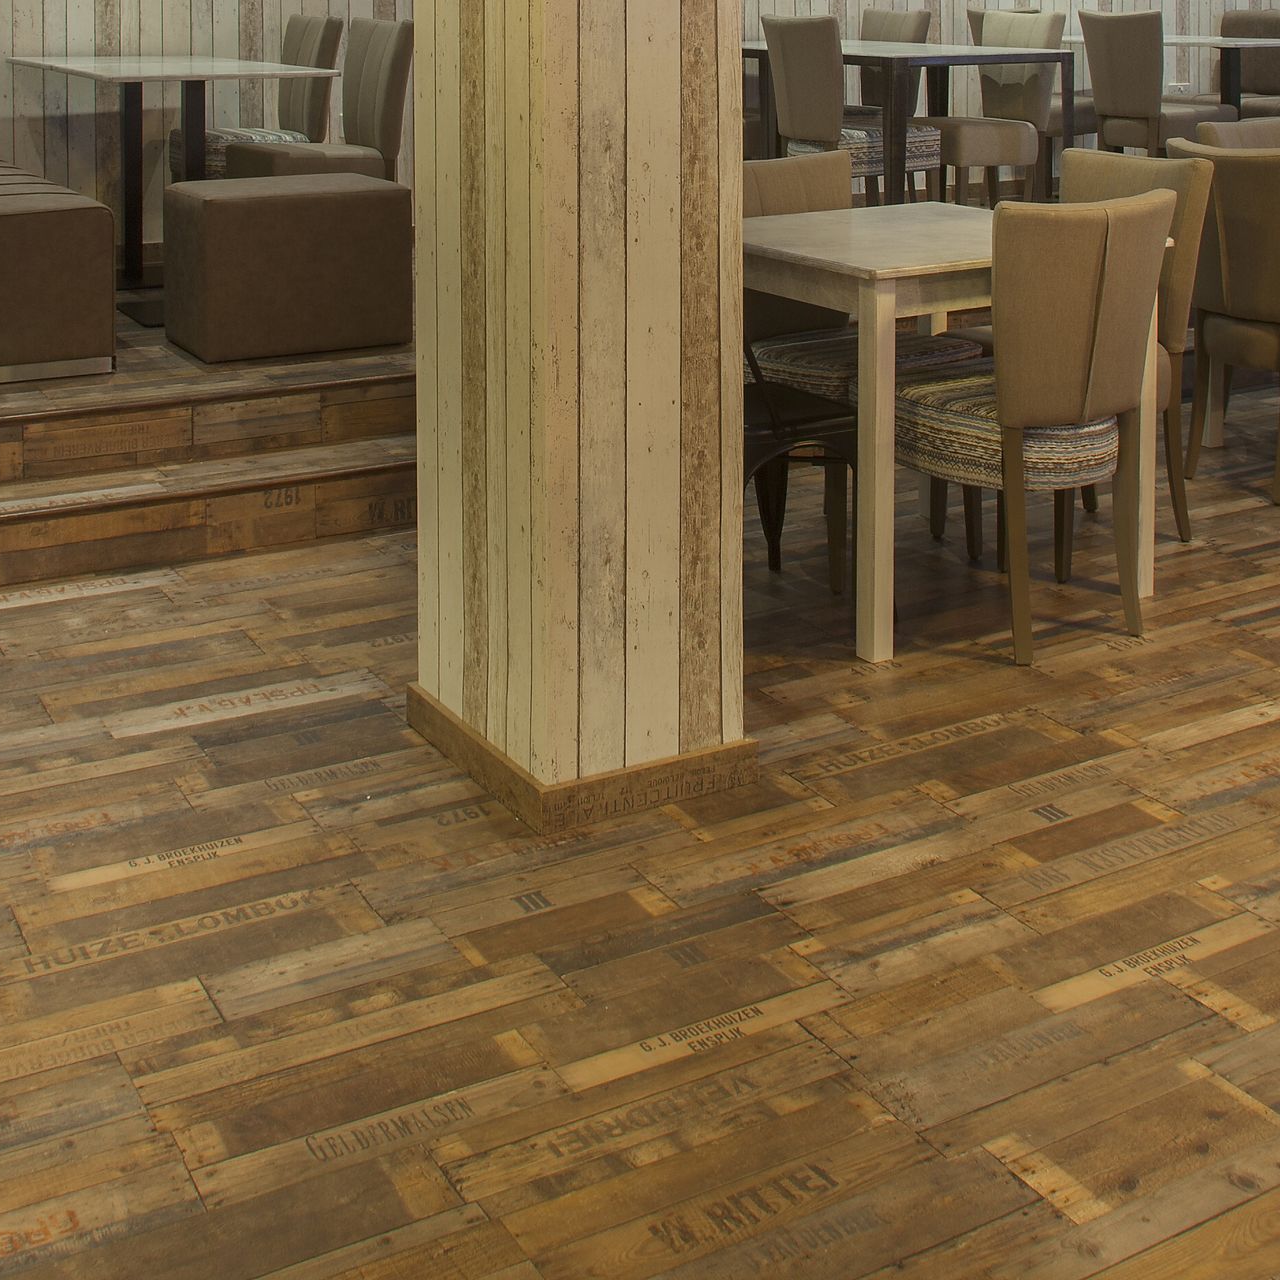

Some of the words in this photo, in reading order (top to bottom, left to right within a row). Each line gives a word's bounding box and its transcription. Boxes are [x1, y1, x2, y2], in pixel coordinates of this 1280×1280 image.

[263, 486, 302, 509] 1972
[157, 836, 243, 862] BROEKHUIZEN
[22, 929, 144, 974] HUIZE
[1122, 935, 1201, 969] BROEKHUIZEN
[639, 1040, 657, 1053] G.
[669, 1005, 765, 1043] BROEKHUIZEN
[686, 1025, 748, 1053] ENSPIJK
[303, 1095, 476, 1163] GELDERMALSEN
